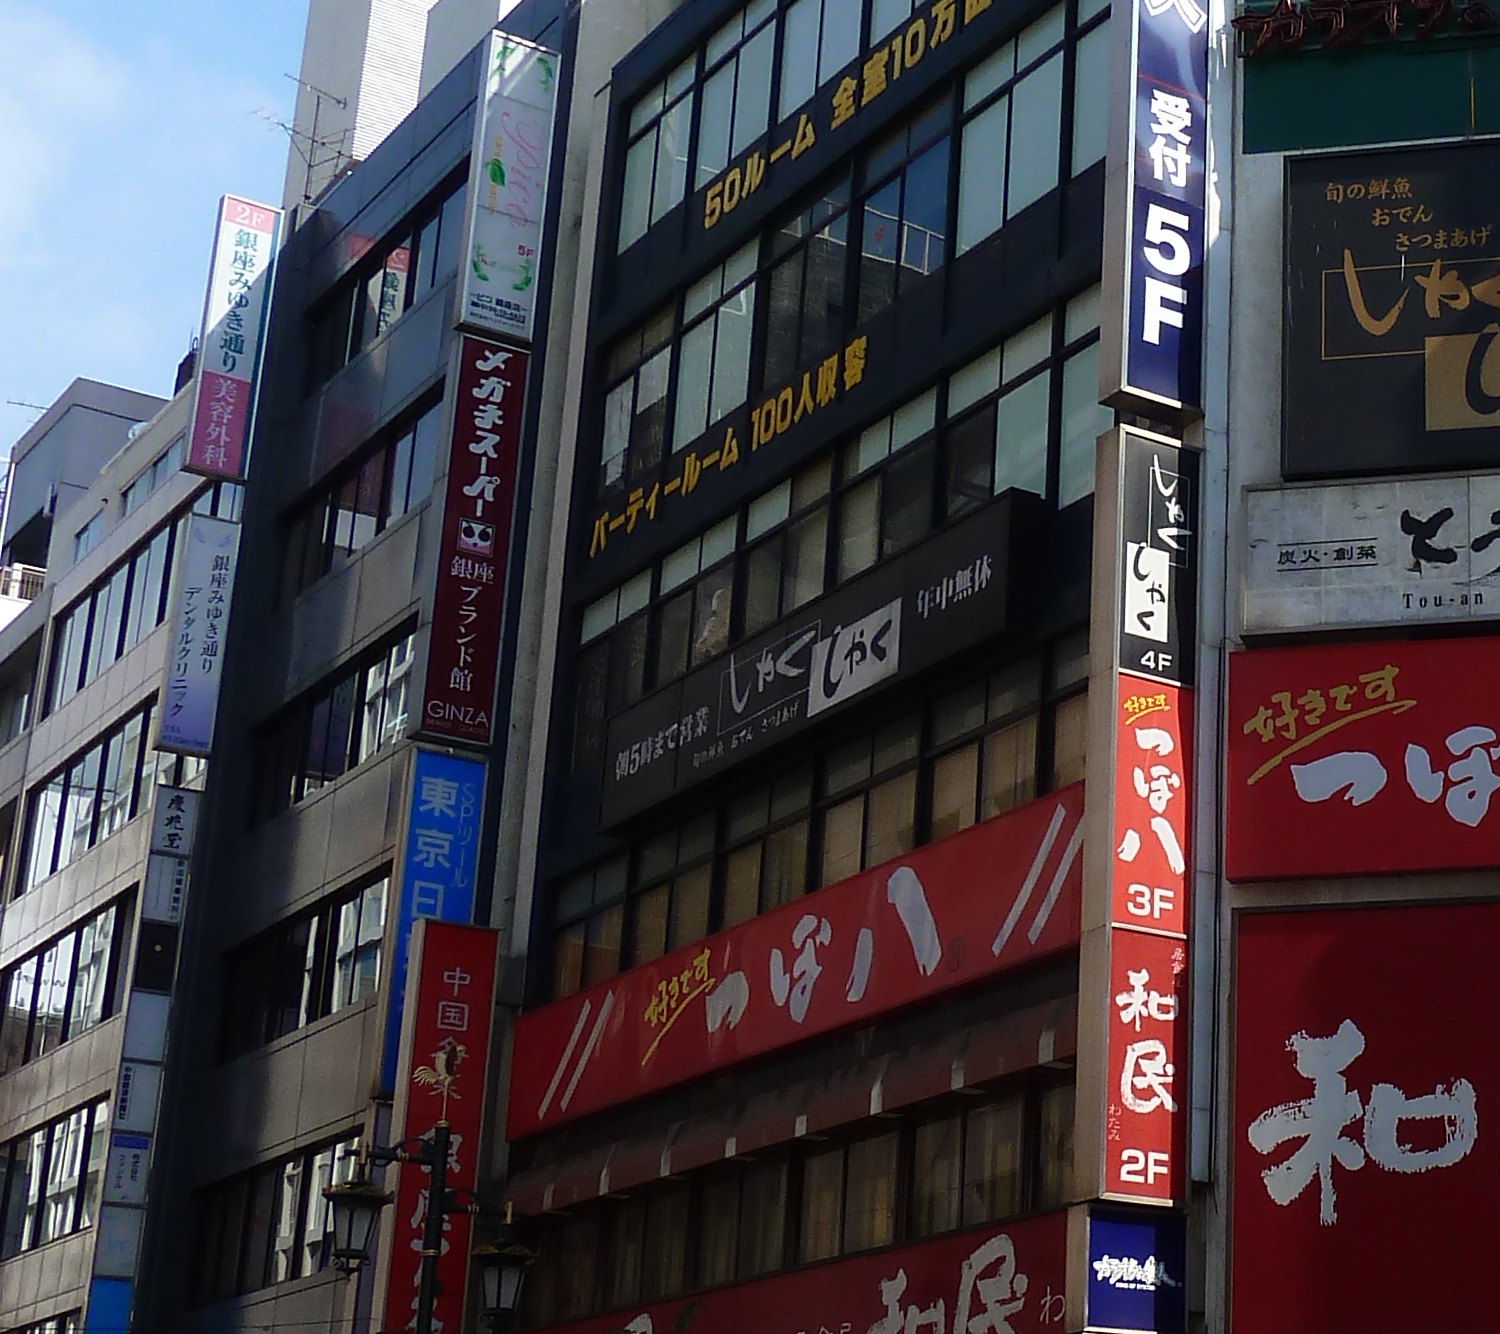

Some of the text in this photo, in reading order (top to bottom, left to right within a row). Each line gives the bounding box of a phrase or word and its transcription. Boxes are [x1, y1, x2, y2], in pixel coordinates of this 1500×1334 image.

[704, 114, 815, 229] 50ルーム
[1149, 89, 1193, 187] 受付
[236, 205, 265, 228] 2F
[1324, 178, 1413, 202] 旬の鮮魚
[1372, 204, 1433, 226] おでん
[1142, 203, 1192, 345] 5F
[1395, 225, 1491, 252] さつまあげ
[218, 228, 258, 373] 銀座みゆき通り
[202, 378, 237, 468] 美容外科
[463, 348, 513, 517] メガネスーパー
[751, 335, 868, 452] 100人収容
[1154, 453, 1193, 551] しゃく
[201, 555, 230, 675] 銀座みゆき通り
[450, 556, 494, 585] 銀座
[917, 553, 993, 620] 年中無休
[1132, 541, 1166, 632] しゃく
[1402, 592, 1485, 610] Tou-an
[171, 586, 202, 717] デンタルクリニック
[449, 585, 483, 692] ブランド館
[729, 617, 893, 715] しゃく しゃく
[1140, 650, 1173, 671] 4F
[427, 699, 490, 728] GINZA
[615, 705, 710, 782] 朝5時まで営業
[730, 726, 755, 749] おでん
[1124, 692, 1168, 715] 好きです
[1243, 664, 1400, 743] 好きです
[449, 783, 477, 888] SPツール
[1118, 727, 1185, 875] つぼ八
[1126, 882, 1175, 920] 3F
[644, 946, 711, 1027] 好きです
[705, 866, 942, 1033] つぼ八
[1115, 968, 1179, 1114] 和民
[1120, 1148, 1169, 1187] 2F
